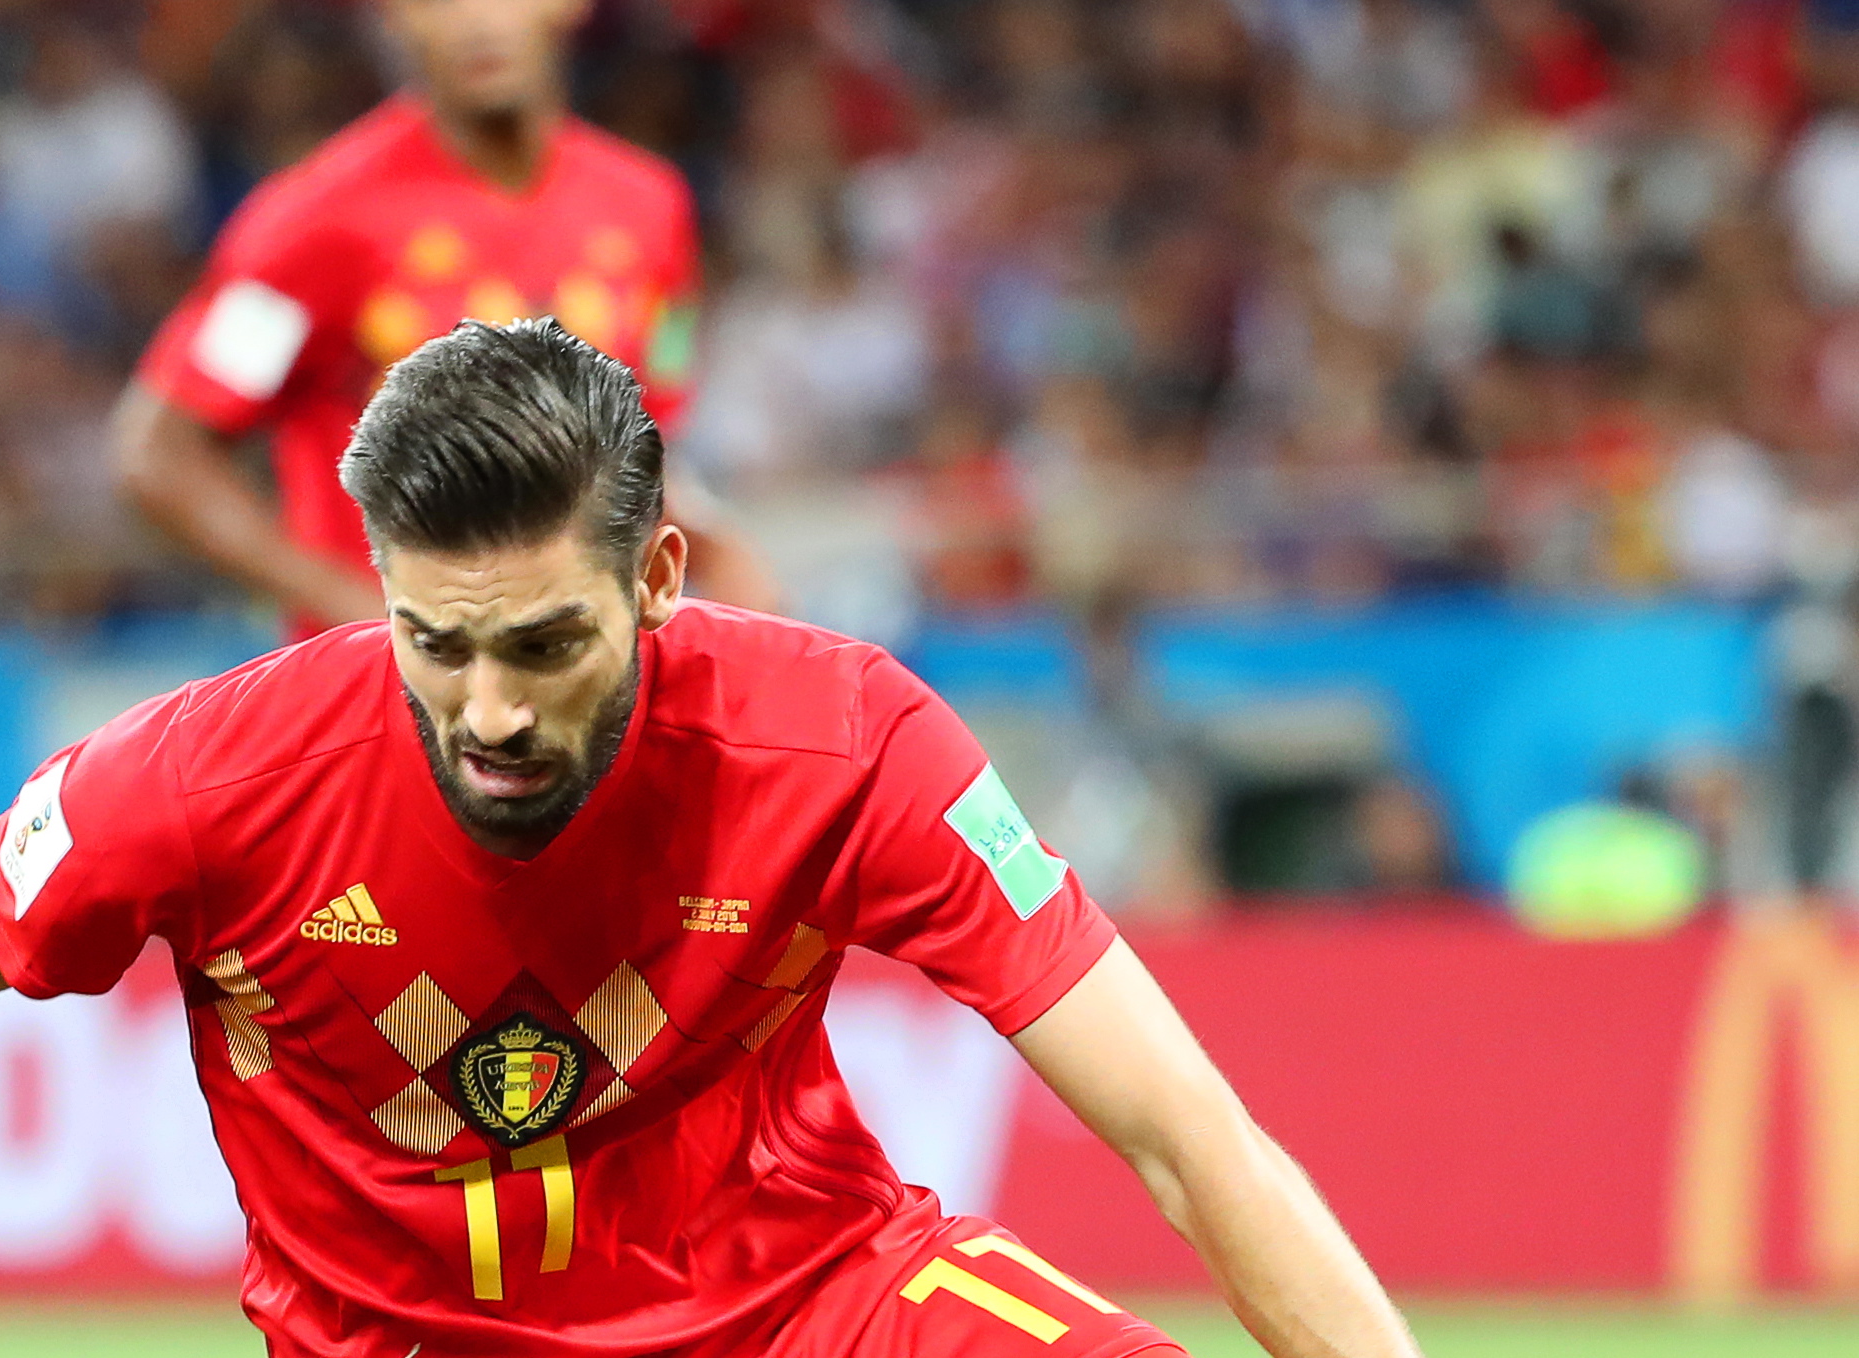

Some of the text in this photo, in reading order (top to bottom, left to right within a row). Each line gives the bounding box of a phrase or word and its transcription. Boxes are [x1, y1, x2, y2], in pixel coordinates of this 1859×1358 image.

[300, 914, 398, 947] adidas
[434, 1135, 576, 1301] 11
[899, 1235, 1123, 1345] 11
